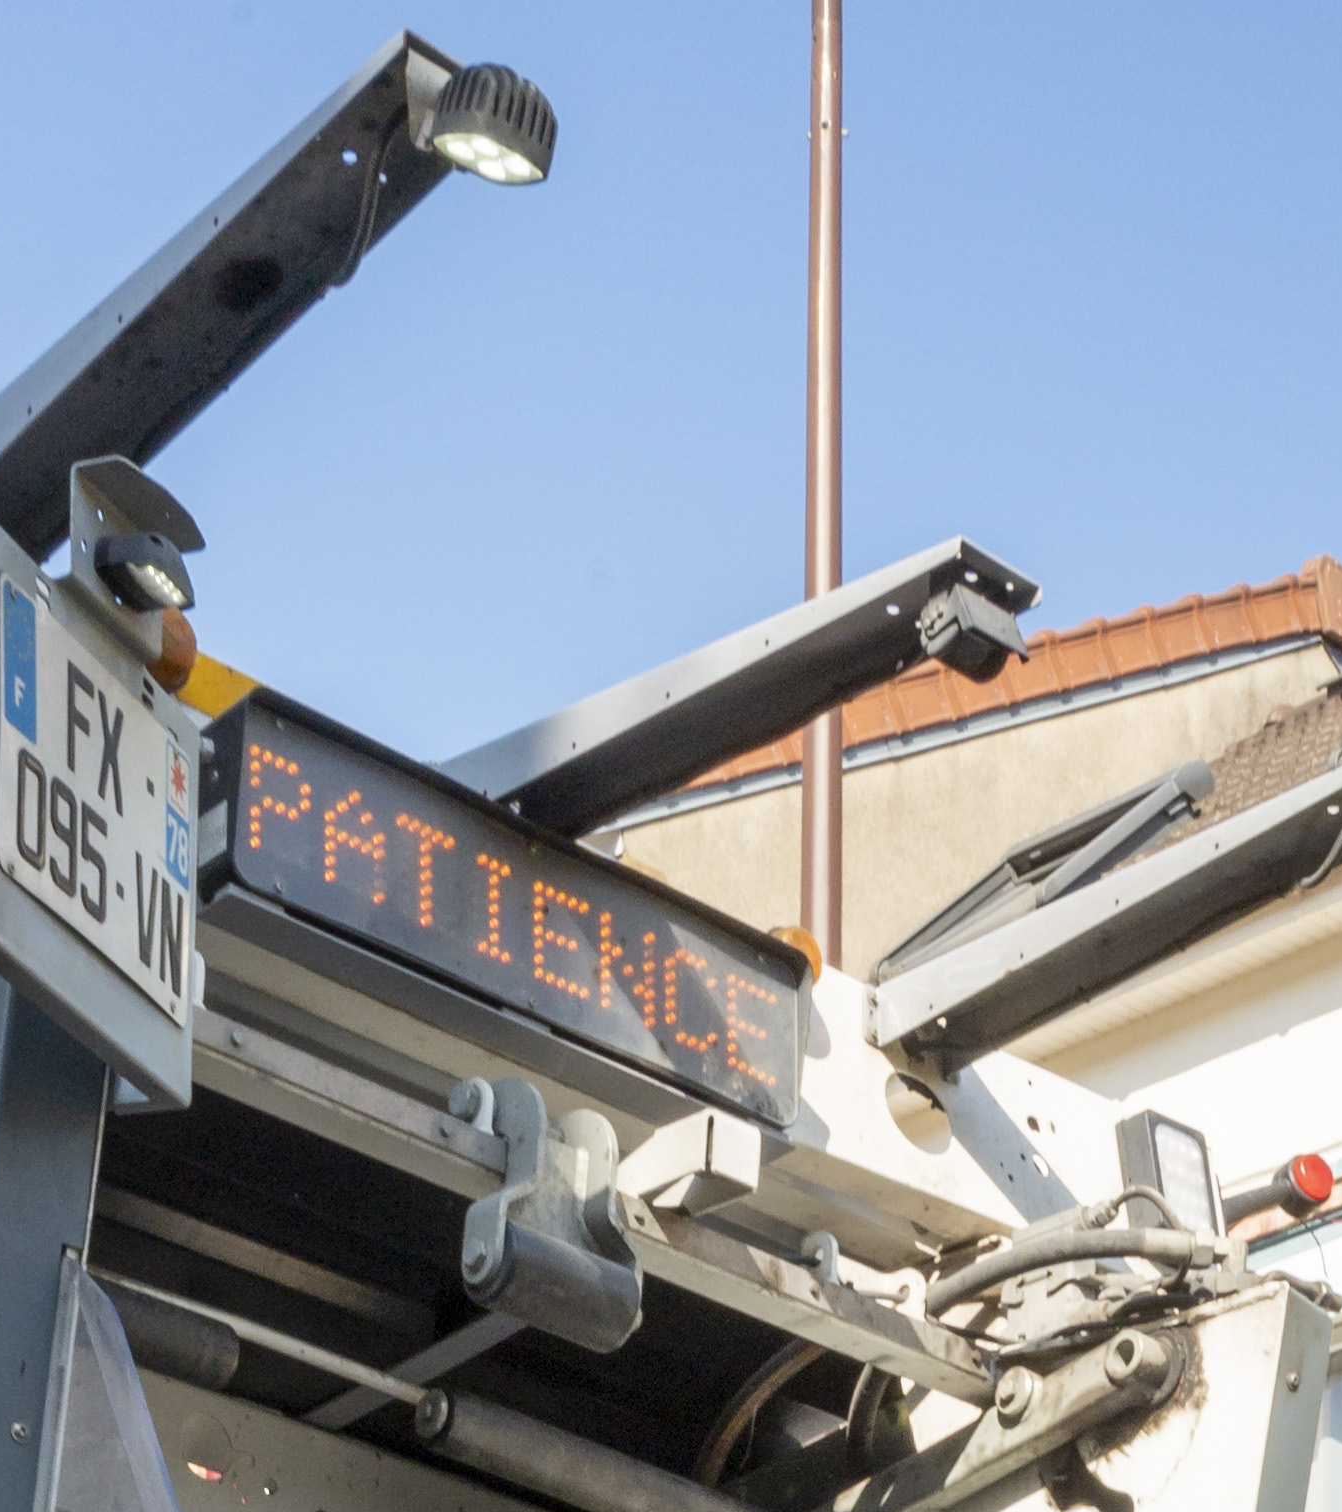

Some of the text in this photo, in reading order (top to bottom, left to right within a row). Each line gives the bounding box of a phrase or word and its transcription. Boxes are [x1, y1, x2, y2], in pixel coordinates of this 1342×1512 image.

[15, 674, 27, 708] F
[167, 816, 189, 887] 78
[250, 745, 777, 1087] PATIENCE
